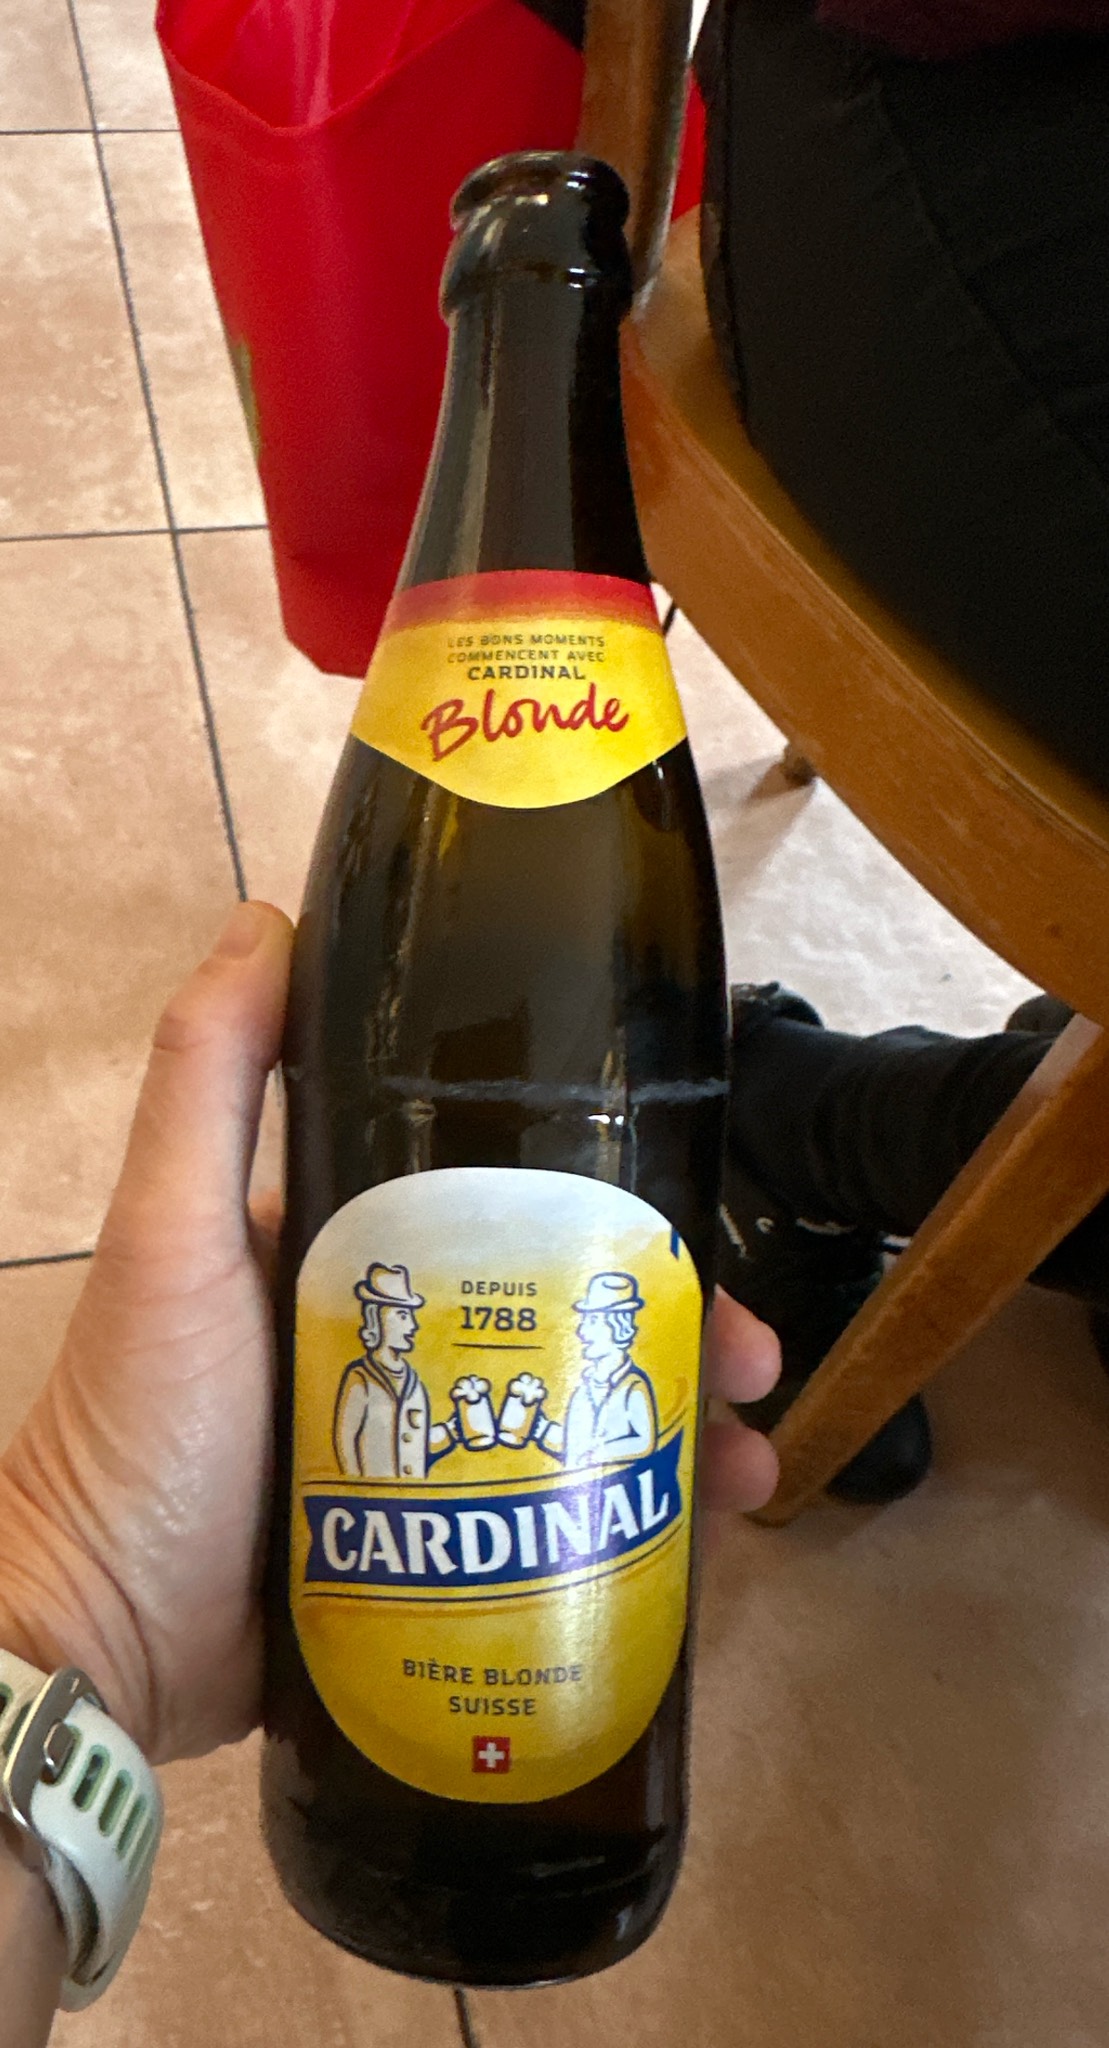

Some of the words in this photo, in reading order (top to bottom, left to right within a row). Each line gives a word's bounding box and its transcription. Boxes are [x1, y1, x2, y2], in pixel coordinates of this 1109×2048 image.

[480, 634, 524, 646] BONS
[530, 634, 606, 648] MOMENTS
[447, 649, 560, 664] COMMENCENT
[567, 651, 606, 663] AVEC
[467, 665, 587, 681] CARDINAL
[420, 682, 630, 762] Blonde
[460, 1279, 538, 1297] DEPUIS
[459, 1306, 538, 1332] 1788
[321, 1468, 671, 1576] CARDINAL
[402, 1656, 475, 1685] BIÈRE
[484, 1663, 584, 1686] BLONDE
[448, 1696, 538, 1716] SUISSE
